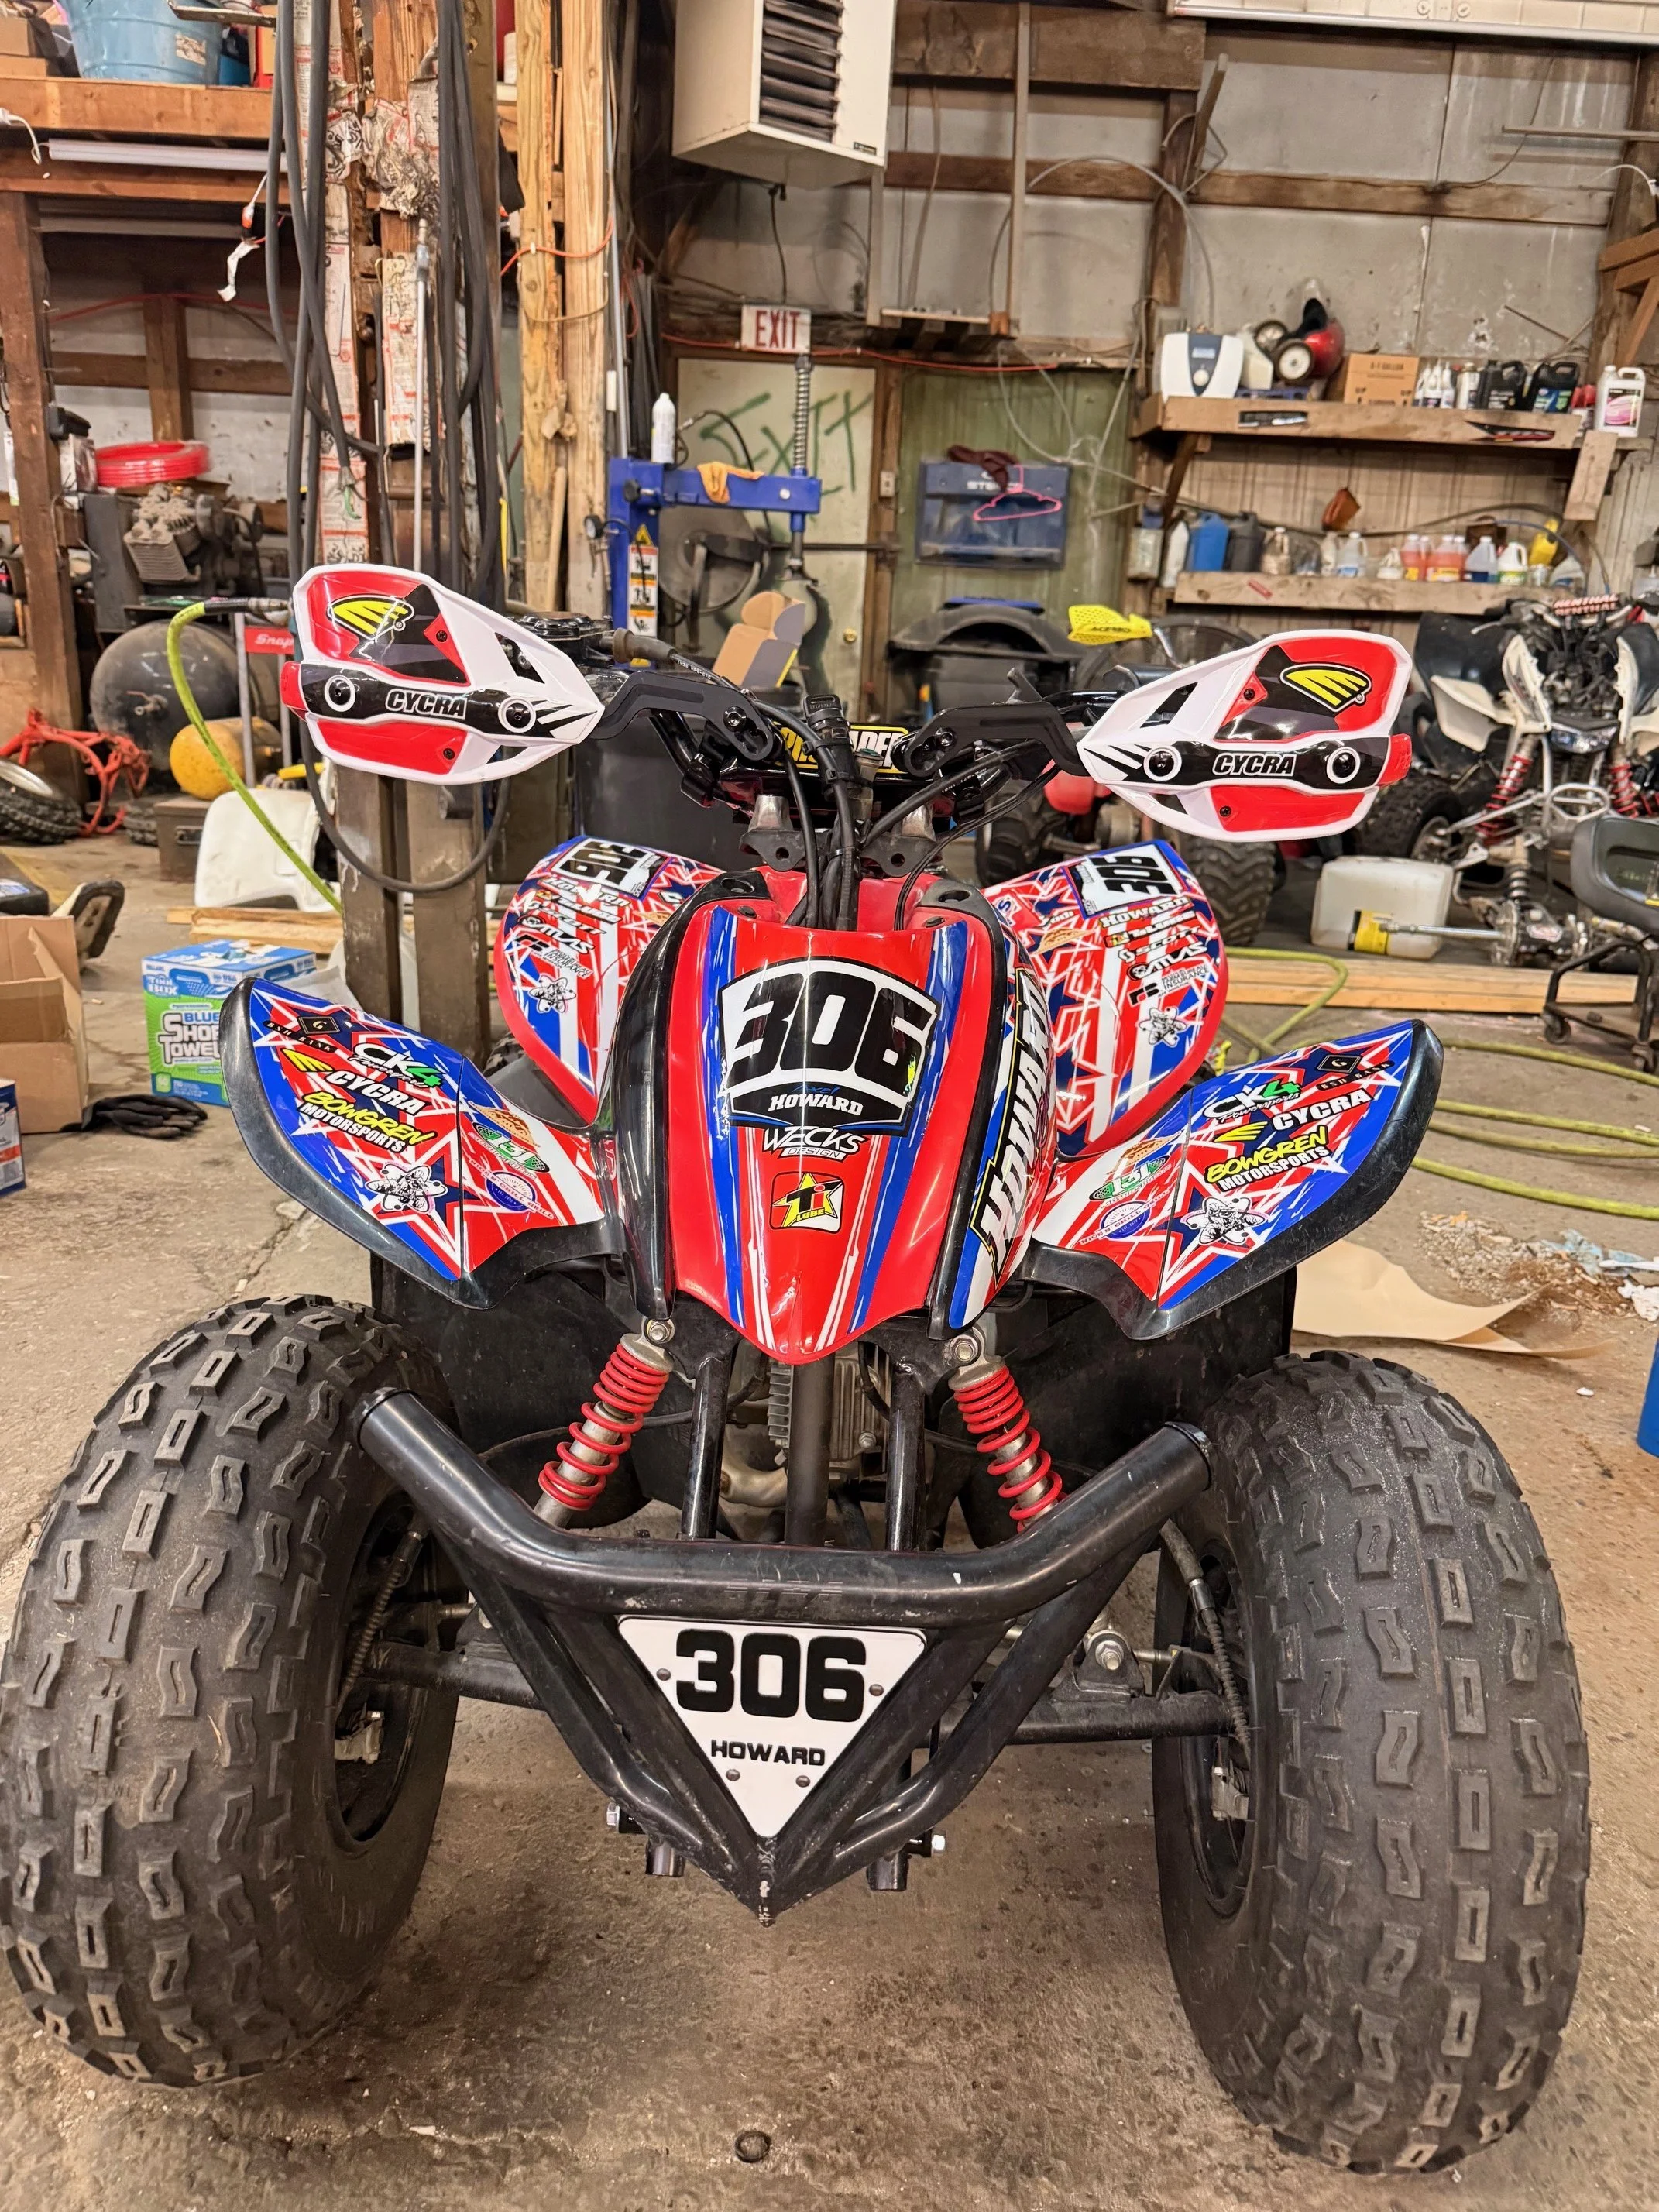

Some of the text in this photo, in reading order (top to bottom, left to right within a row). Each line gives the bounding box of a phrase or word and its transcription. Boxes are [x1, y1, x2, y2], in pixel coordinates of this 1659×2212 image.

[756, 310, 801, 349] EXIT
[386, 689, 466, 719] CYCRA
[1213, 754, 1296, 775] CYCRA
[1089, 856, 1178, 895] 306
[1100, 896, 1189, 928] HOWARD
[1136, 926, 1200, 955] SCOTT
[544, 953, 589, 977] INSURANCE
[1147, 941, 1207, 976] ATLAS
[1164, 968, 1209, 991] INSURANCE
[184, 1012, 220, 1022] BLUE
[726, 971, 934, 1097] 306
[298, 1036, 331, 1052] BANK
[355, 1043, 441, 1087] CK4
[1354, 1063, 1390, 1079] BANK
[325, 1070, 426, 1115] CYCRA
[768, 1093, 864, 1116] HOWARD
[1204, 1080, 1300, 1118] CK4
[1216, 1092, 1300, 1123] Powersports
[1273, 1087, 1372, 1131] CYCRA
[300, 1103, 405, 1152] MOTORSPORTS
[304, 1091, 435, 1144] BOWGREN
[980, 974, 1049, 1274] HOWARD
[763, 1125, 866, 1153] WECKS
[787, 1146, 841, 1159] DESIGN
[1207, 1125, 1328, 1183] BOWGREN
[1218, 1146, 1330, 1191] MOTORSPORTS
[500, 1183, 525, 1201] CHILL
[527, 1201, 553, 1218] GRILL
[786, 1180, 843, 1213] Ti
[796, 1207, 826, 1222] LUBE
[1082, 1231, 1103, 1244] NICE
[1115, 1211, 1141, 1228] CHILL
[1144, 1189, 1170, 1209] GRILL
[676, 1627, 867, 1723] 306
[711, 1739, 826, 1766] HOWARD
